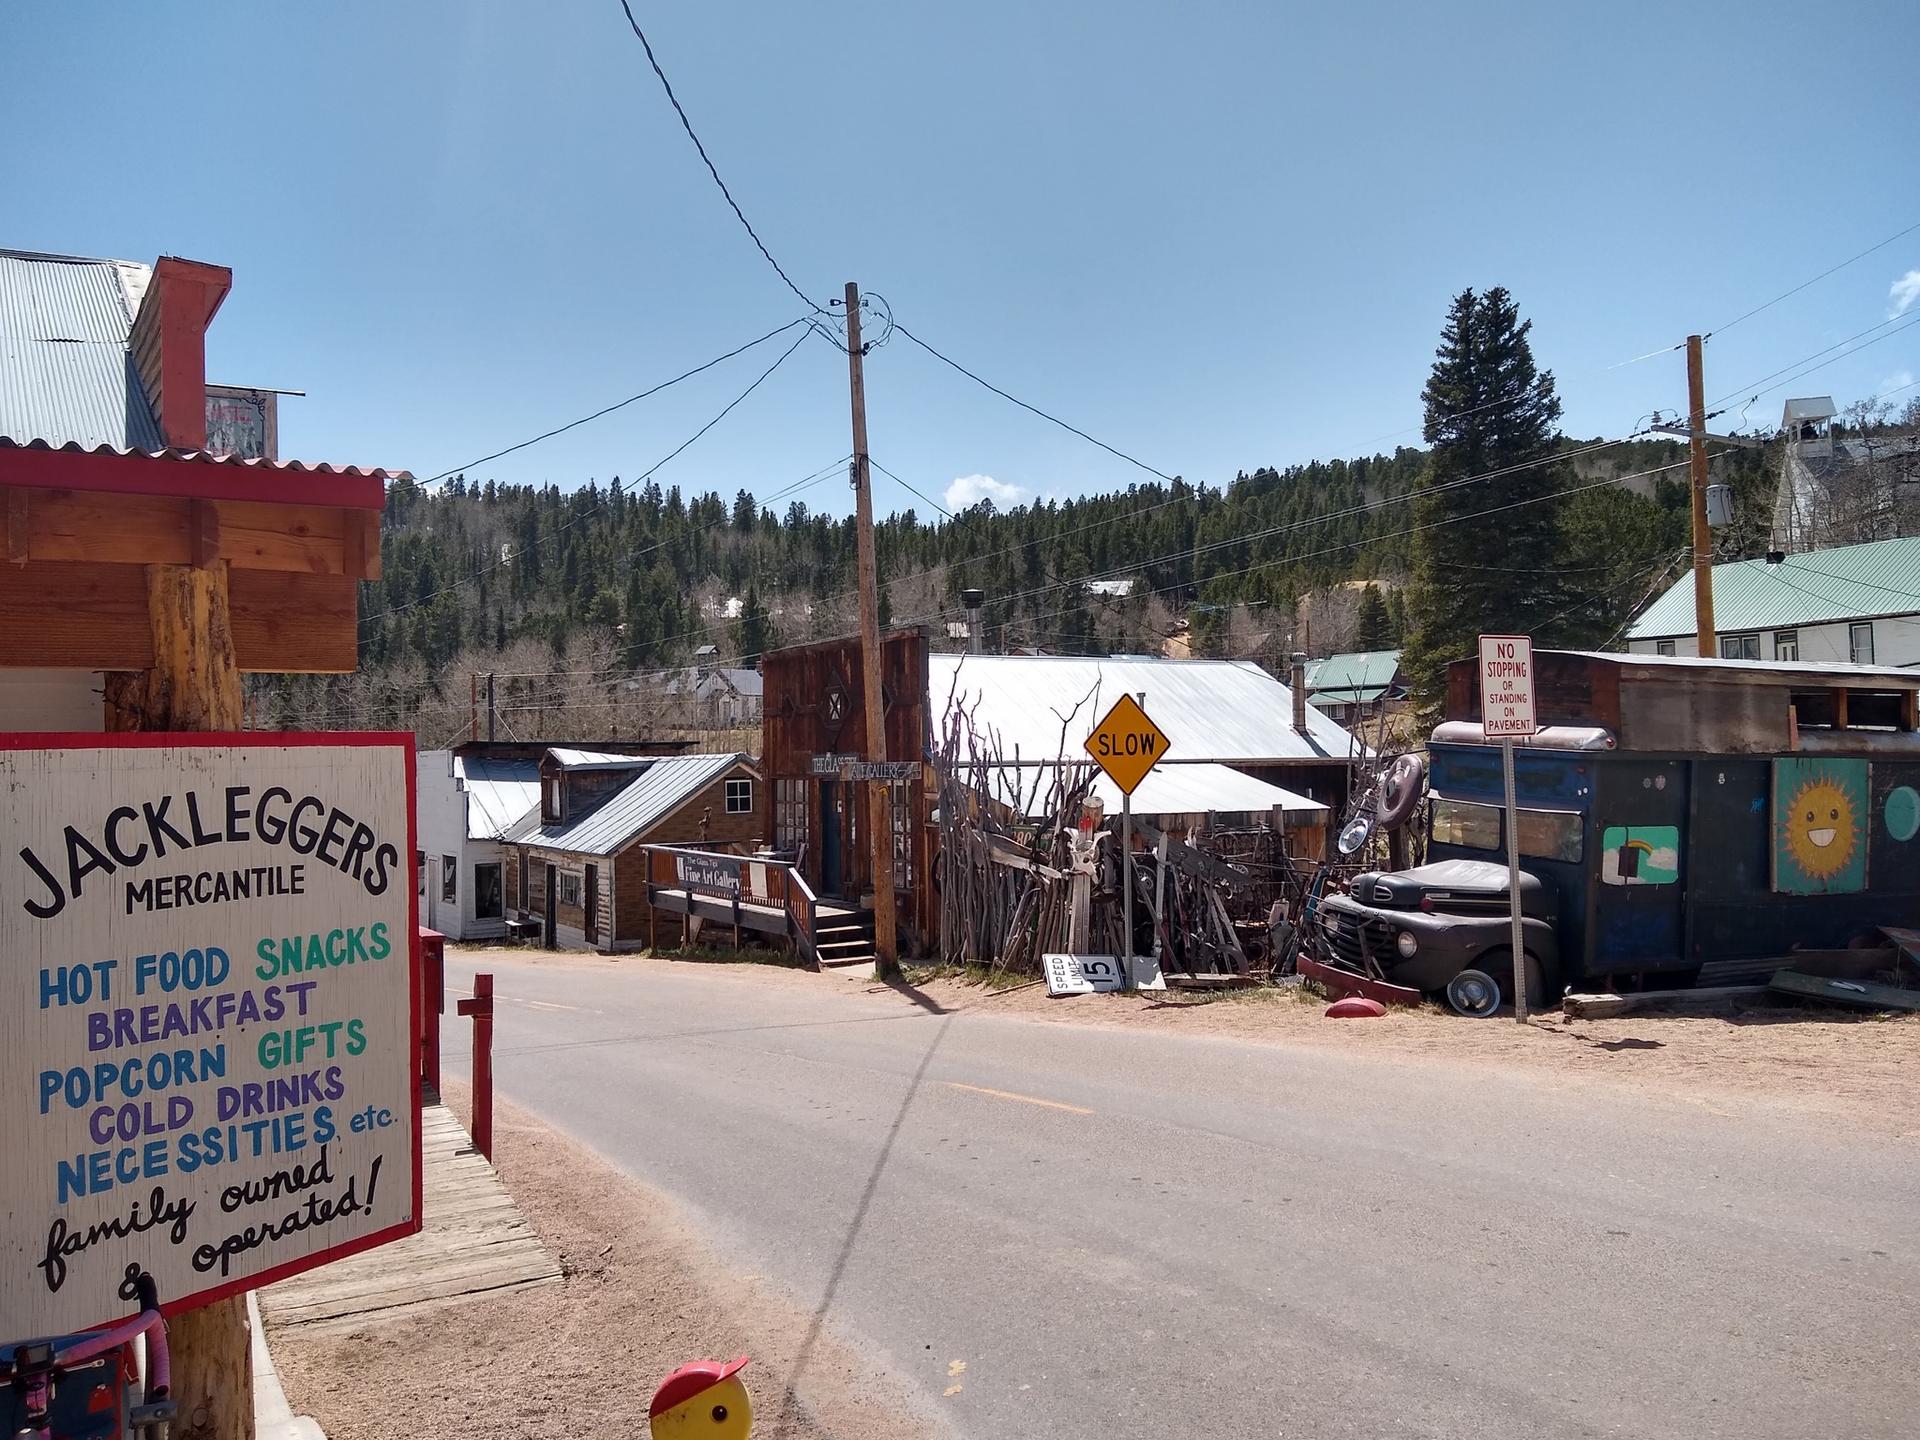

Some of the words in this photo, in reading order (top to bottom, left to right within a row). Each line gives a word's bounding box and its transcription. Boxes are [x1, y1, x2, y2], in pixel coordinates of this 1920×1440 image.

[1497, 643, 1515, 659] NO
[1487, 661, 1527, 678] STOPPING
[1489, 693, 1528, 704] STANDING
[1502, 680, 1513, 691] OR
[1488, 719, 1530, 731] PAVEMENT
[1504, 707, 1515, 717] ON
[1098, 733, 1155, 757] SLOW
[19, 786, 399, 919] JACKLEGGERS
[687, 857, 696, 865] The
[696, 859, 709, 867] Glass
[126, 864, 306, 914] MERCANTILE
[685, 866, 701, 883] Fine
[702, 869, 714, 886] Art
[714, 870, 740, 895] Gallery
[40, 959, 118, 1009] HOT
[135, 946, 230, 996] FOOD
[255, 922, 391, 981] SNACKS
[1052, 957, 1068, 989] SPEED
[1068, 961, 1084, 986] LIMIT
[1083, 961, 1114, 983] 15
[88, 981, 318, 1052] BREAKFAST
[40, 1044, 226, 1114] POPCORN
[258, 1018, 367, 1070] GIFTS
[89, 1096, 194, 1146] COLD
[217, 1066, 345, 1123] DRINKS
[349, 1104, 399, 1134] etc.
[37, 1187, 197, 1292] family
[219, 1144, 334, 1213] owned
[118, 1262, 150, 1301] &
[192, 1155, 384, 1277] operated!
